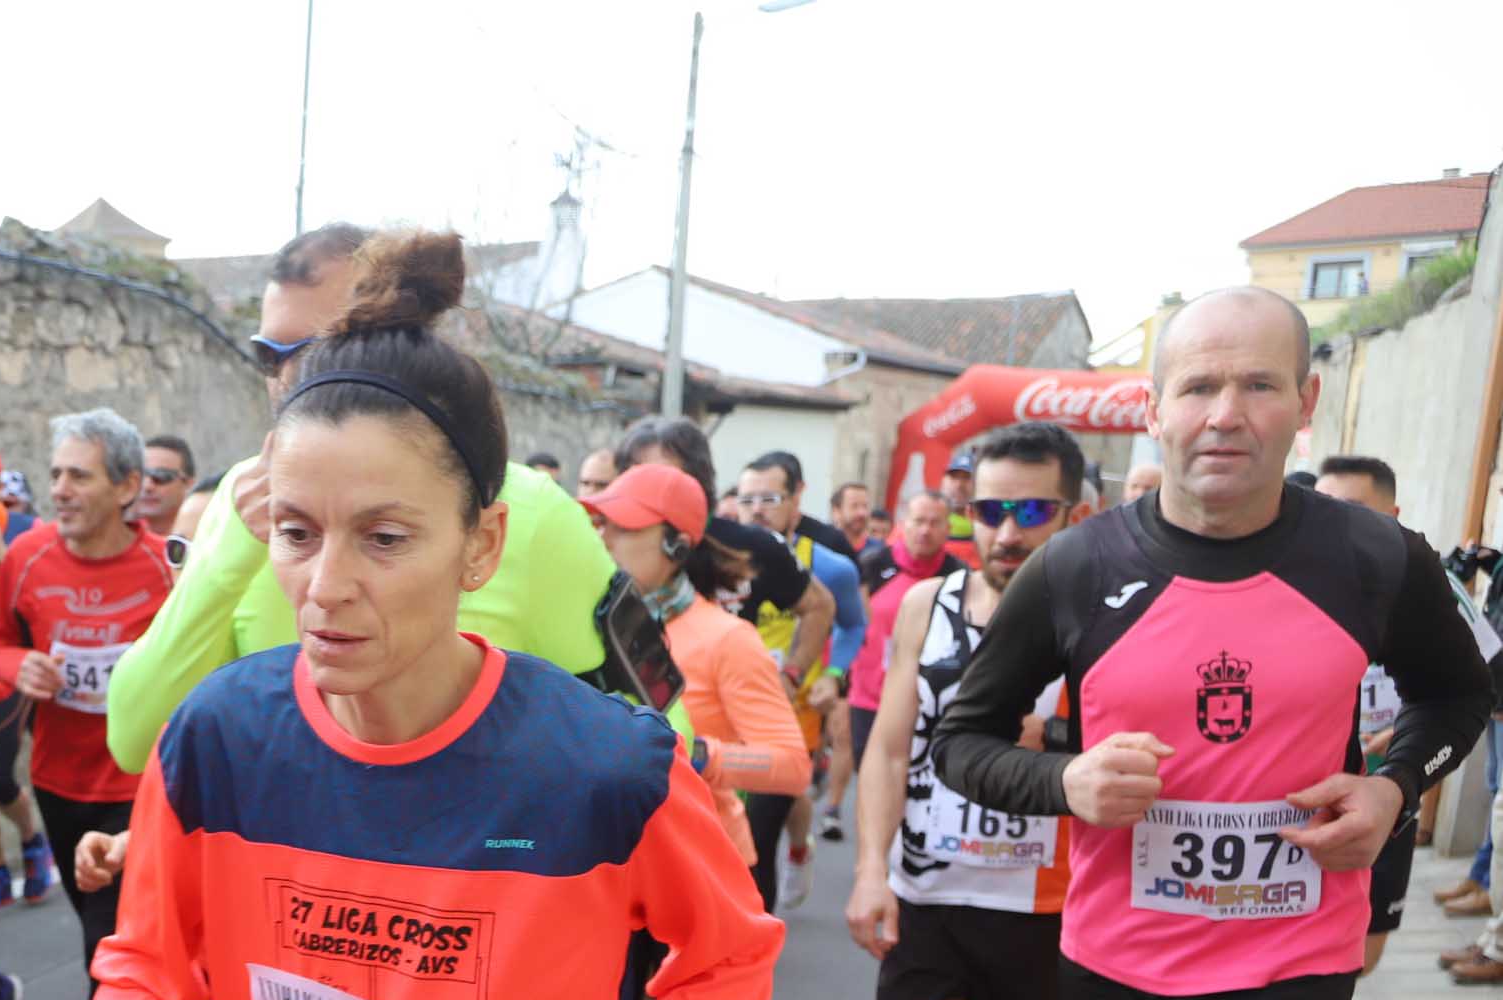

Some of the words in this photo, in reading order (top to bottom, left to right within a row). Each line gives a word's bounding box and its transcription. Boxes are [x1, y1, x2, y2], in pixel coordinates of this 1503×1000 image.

[1013, 376, 1153, 427] Coca-Col
[956, 799, 1028, 839] 165
[1170, 832, 1285, 882] 397
[1144, 876, 1307, 907] JOMISAGA
[1218, 904, 1305, 917] REFORMAS
[290, 896, 314, 924] 27
[321, 905, 378, 937] LIGA
[387, 914, 473, 952] CROSS
[415, 955, 459, 975] AVS
